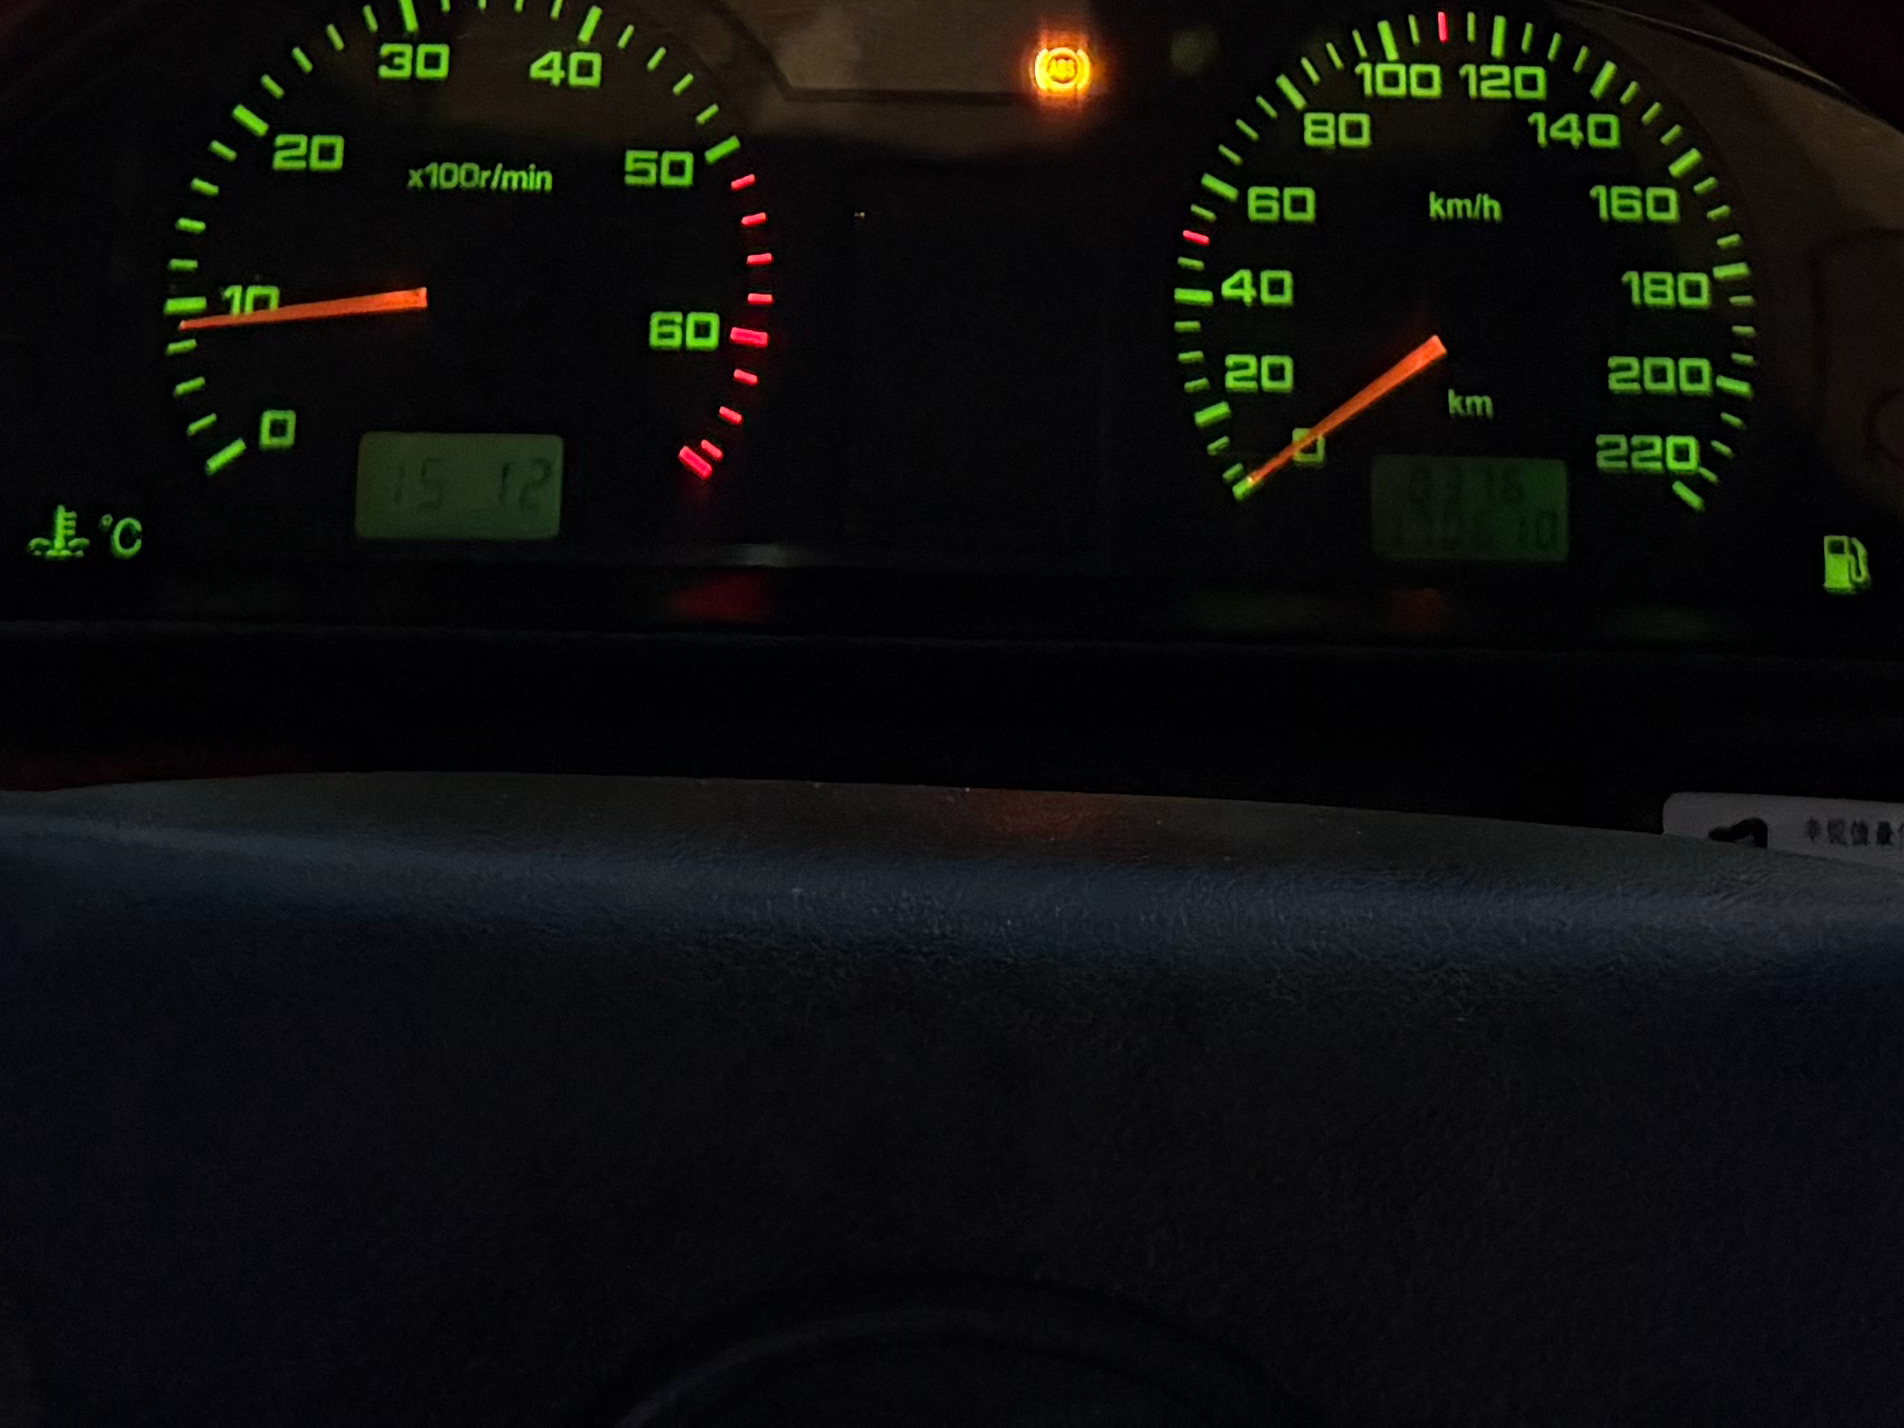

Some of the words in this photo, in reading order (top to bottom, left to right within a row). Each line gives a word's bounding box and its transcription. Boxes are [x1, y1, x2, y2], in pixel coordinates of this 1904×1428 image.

[377, 43, 450, 80] 30
[529, 50, 603, 88] 40
[1355, 62, 1442, 99] 100
[1459, 63, 1547, 101] 120
[1303, 111, 1371, 149] 80
[1527, 111, 1621, 149] 140
[272, 133, 345, 171] 20
[624, 149, 695, 187] 50
[408, 161, 553, 193] x100r/min
[1247, 185, 1316, 223] 60
[1429, 190, 1502, 221] km/h
[1589, 185, 1680, 223] 160
[222, 284, 280, 316] 10
[1221, 267, 1293, 306] 40
[1622, 271, 1711, 309] 180
[649, 310, 721, 351] 60
[1224, 353, 1294, 393] 20
[1607, 355, 1713, 395] 200
[1447, 387, 1493, 417] km
[259, 409, 297, 449] 0
[1291, 427, 1326, 465] 0
[1596, 434, 1698, 474] 220
[100, 512, 144, 558] °C
